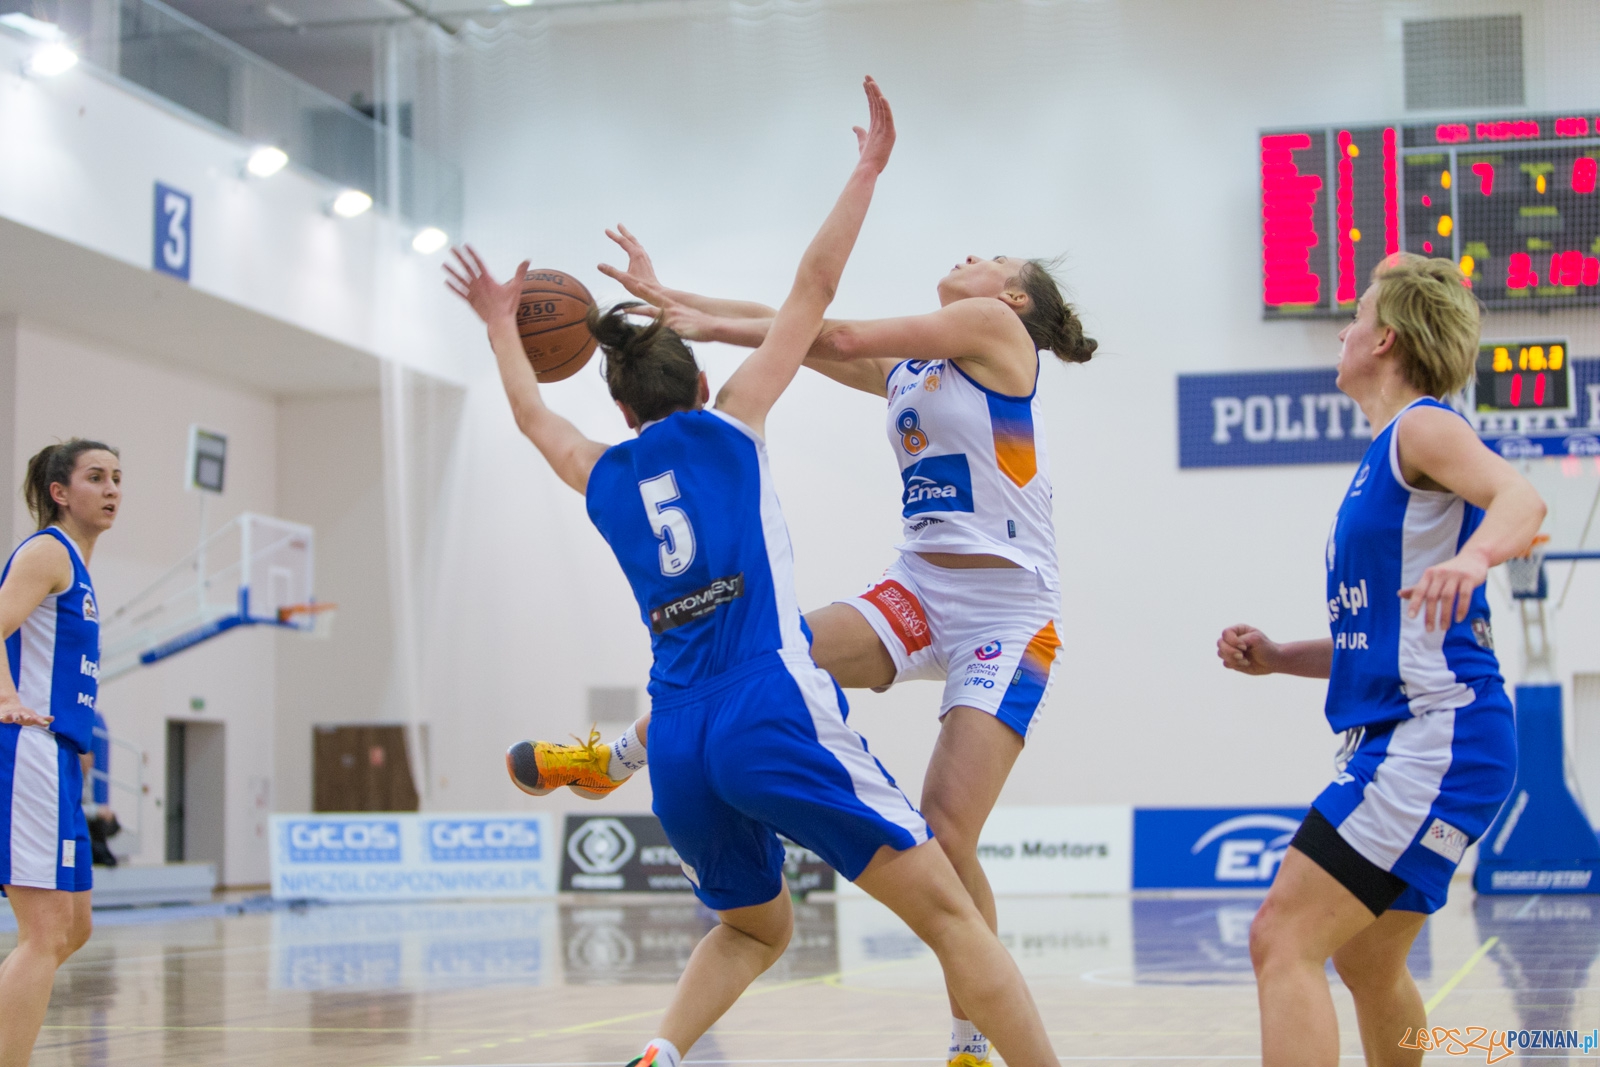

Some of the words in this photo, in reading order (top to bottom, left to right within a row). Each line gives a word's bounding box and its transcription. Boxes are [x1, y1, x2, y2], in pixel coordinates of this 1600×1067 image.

[163, 192, 187, 270] 3
[525, 272, 564, 286] DING
[896, 408, 930, 457] 8
[905, 484, 957, 504] Enea
[638, 469, 697, 578] 5
[1336, 632, 1369, 650] HUR
[1021, 841, 1108, 860] Motors
